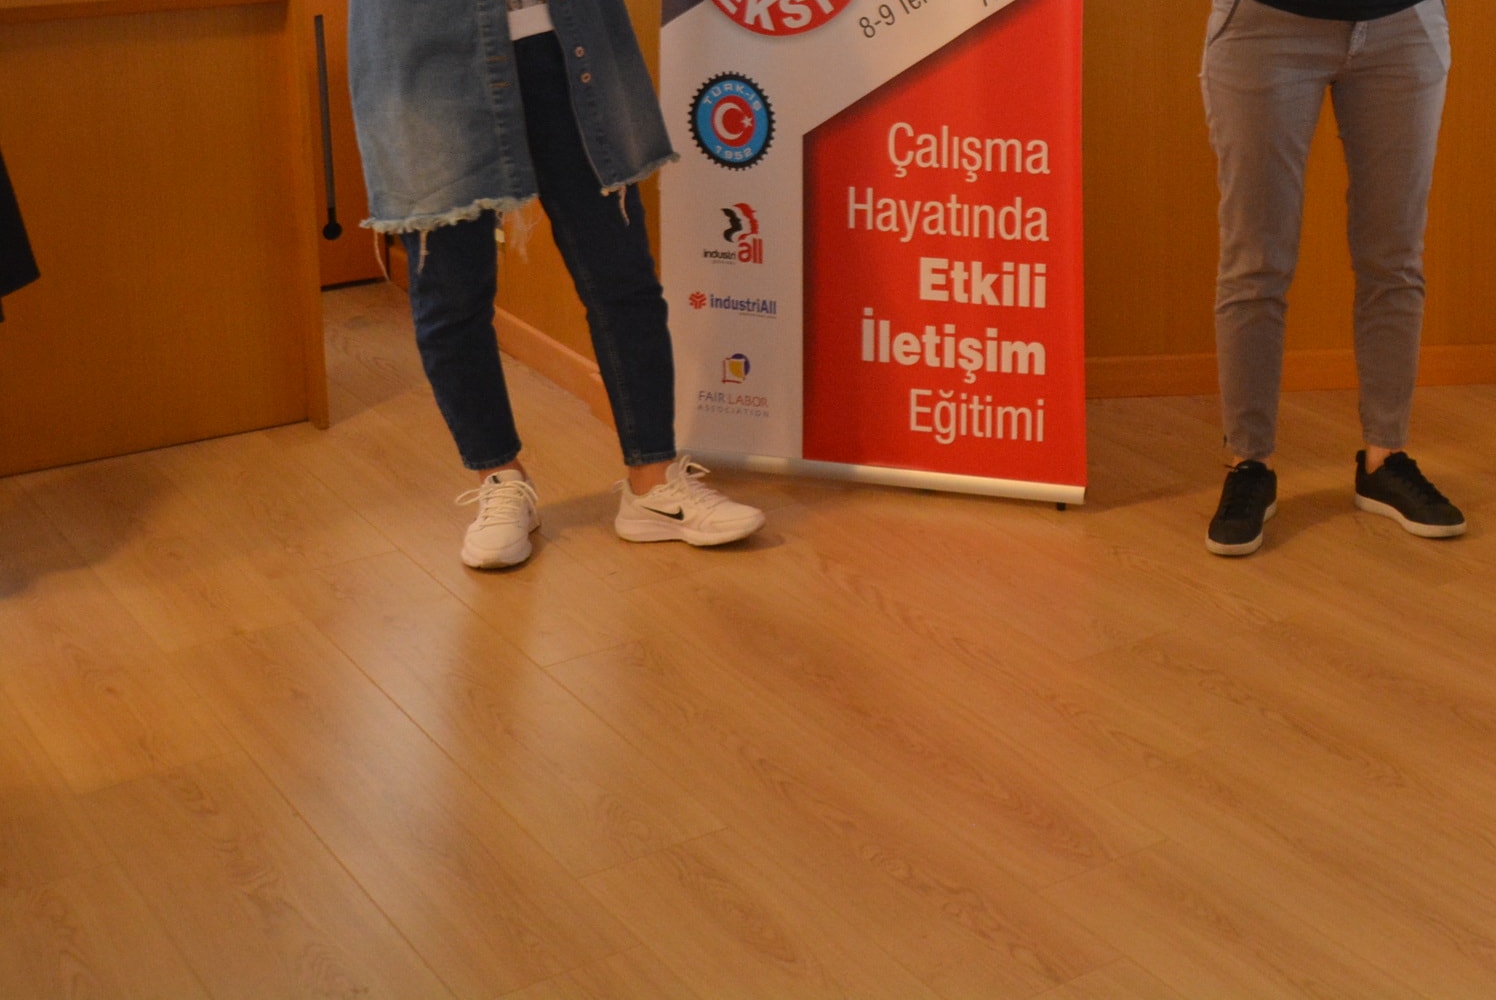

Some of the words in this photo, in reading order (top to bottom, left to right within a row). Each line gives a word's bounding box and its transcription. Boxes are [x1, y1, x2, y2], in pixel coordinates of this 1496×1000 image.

[859, 3, 896, 39] 8-9
[715, 145, 753, 160] 1952
[888, 122, 1050, 182] Çalışma
[848, 186, 1049, 242] Hayatında
[710, 294, 777, 315] industriAll
[919, 256, 1046, 309] Etkili
[861, 307, 1046, 384] İletişim
[698, 390, 725, 402] FAIR
[728, 393, 769, 408] LABOR
[909, 388, 1044, 445] Eğitimi
